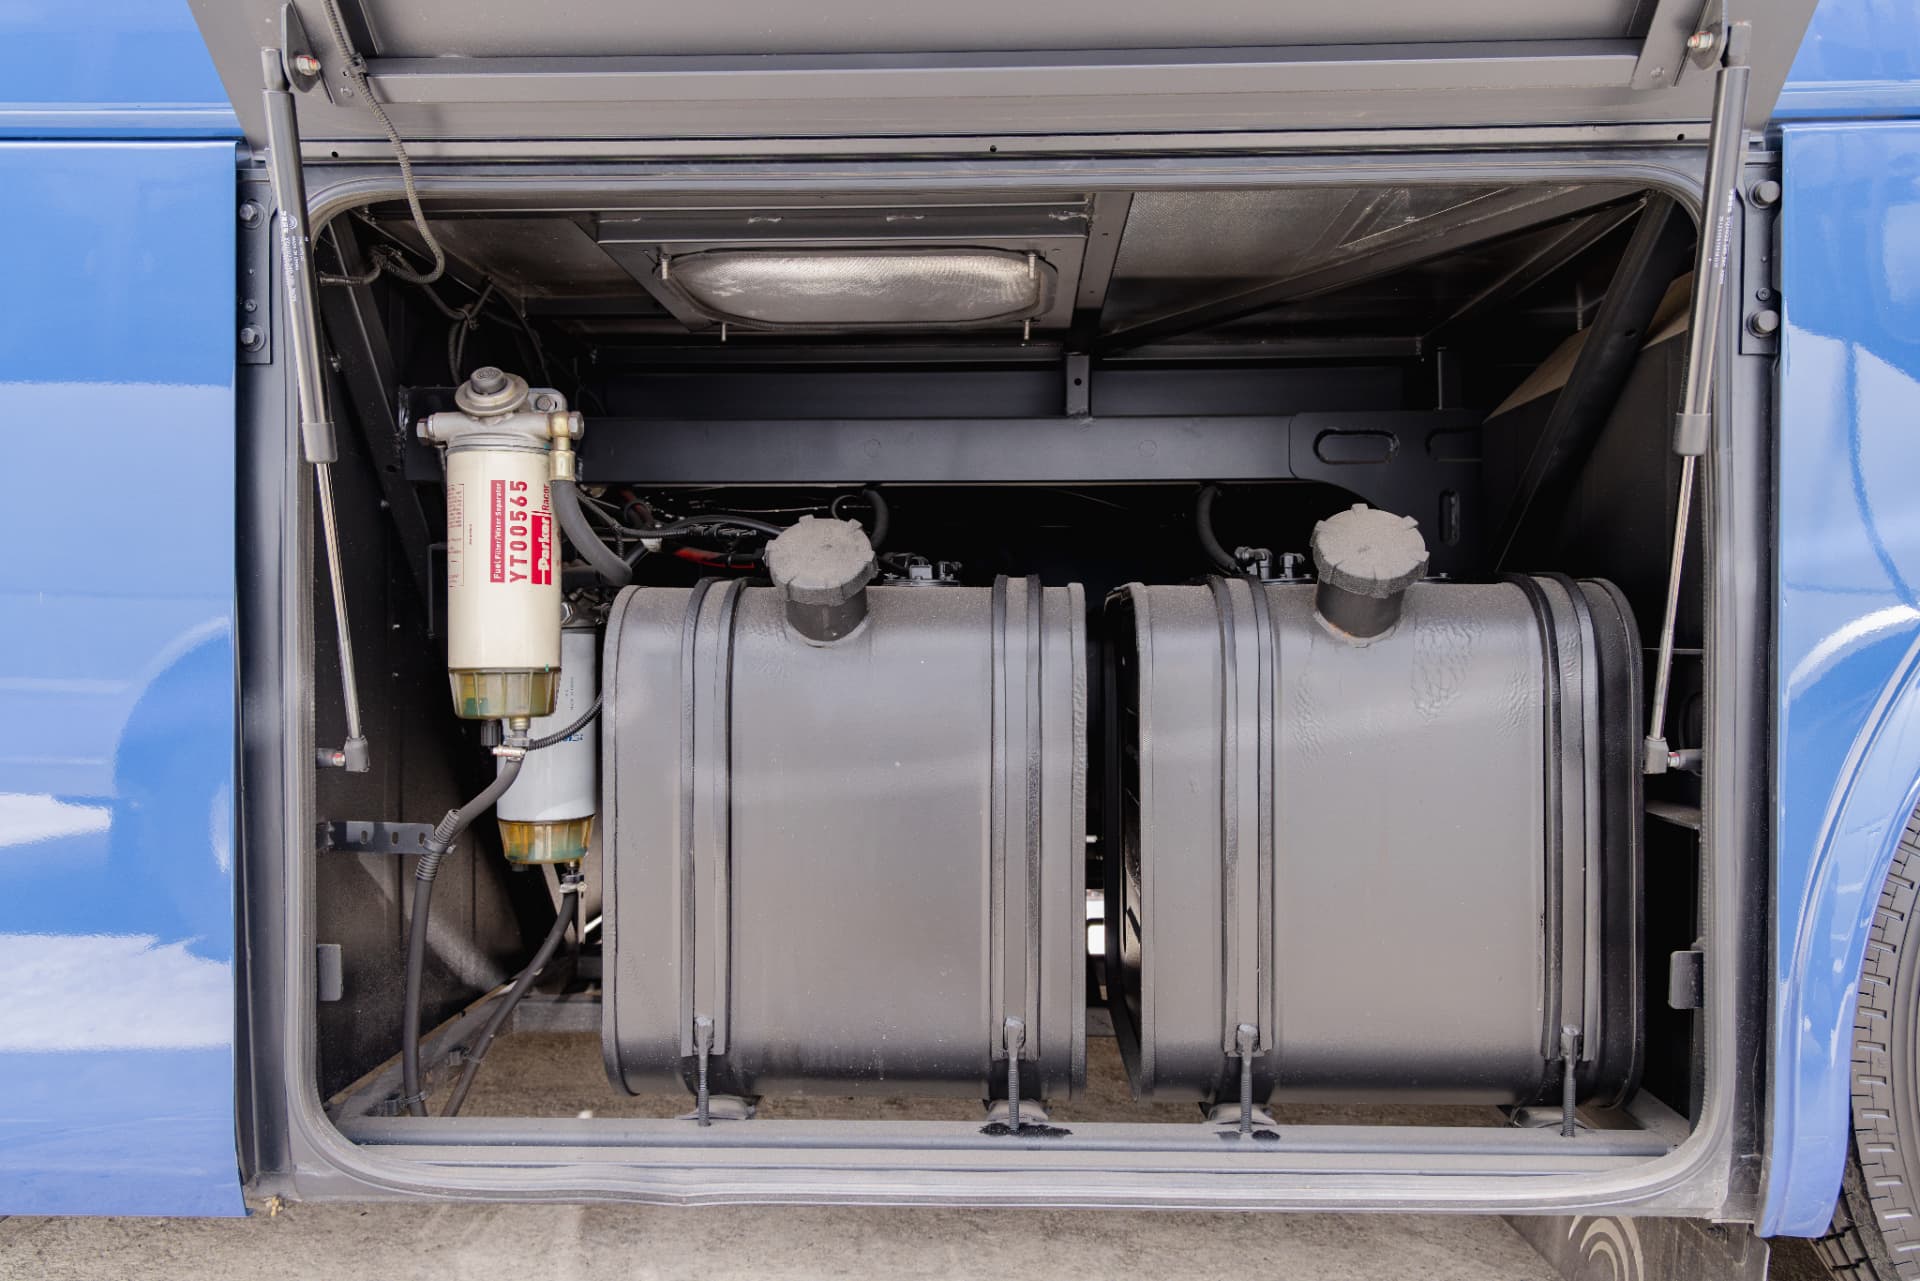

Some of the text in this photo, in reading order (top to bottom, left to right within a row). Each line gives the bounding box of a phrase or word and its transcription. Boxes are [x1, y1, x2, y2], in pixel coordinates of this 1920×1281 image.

[494, 518, 502, 559] Filter/Water
[509, 480, 528, 583] YT00565
[537, 483, 550, 571] Parker Racor
[493, 561, 502, 580] Fuel
